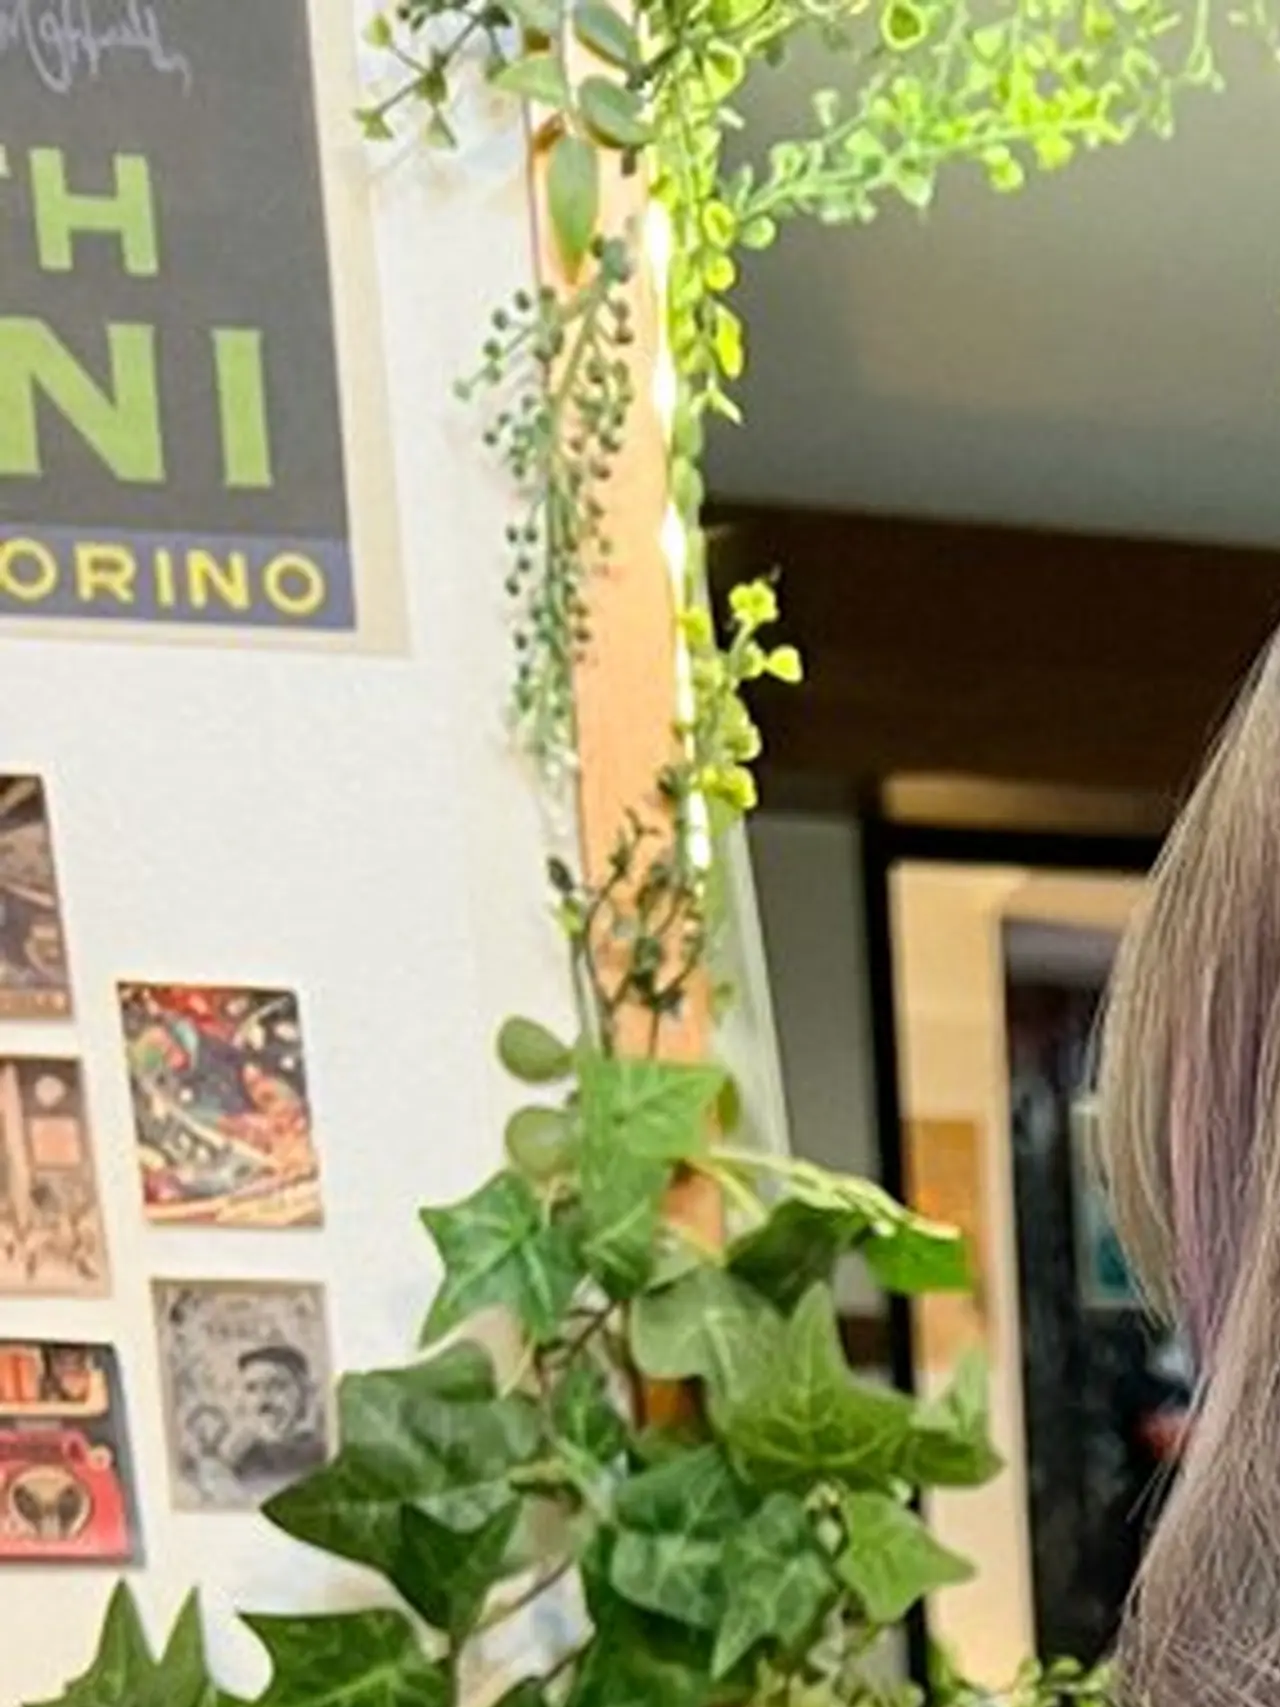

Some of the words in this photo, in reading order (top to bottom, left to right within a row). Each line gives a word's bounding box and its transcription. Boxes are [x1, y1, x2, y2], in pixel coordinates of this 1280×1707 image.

[0, 143, 160, 277] H
[0, 316, 274, 487] NI
[0, 537, 324, 615] ORINO
